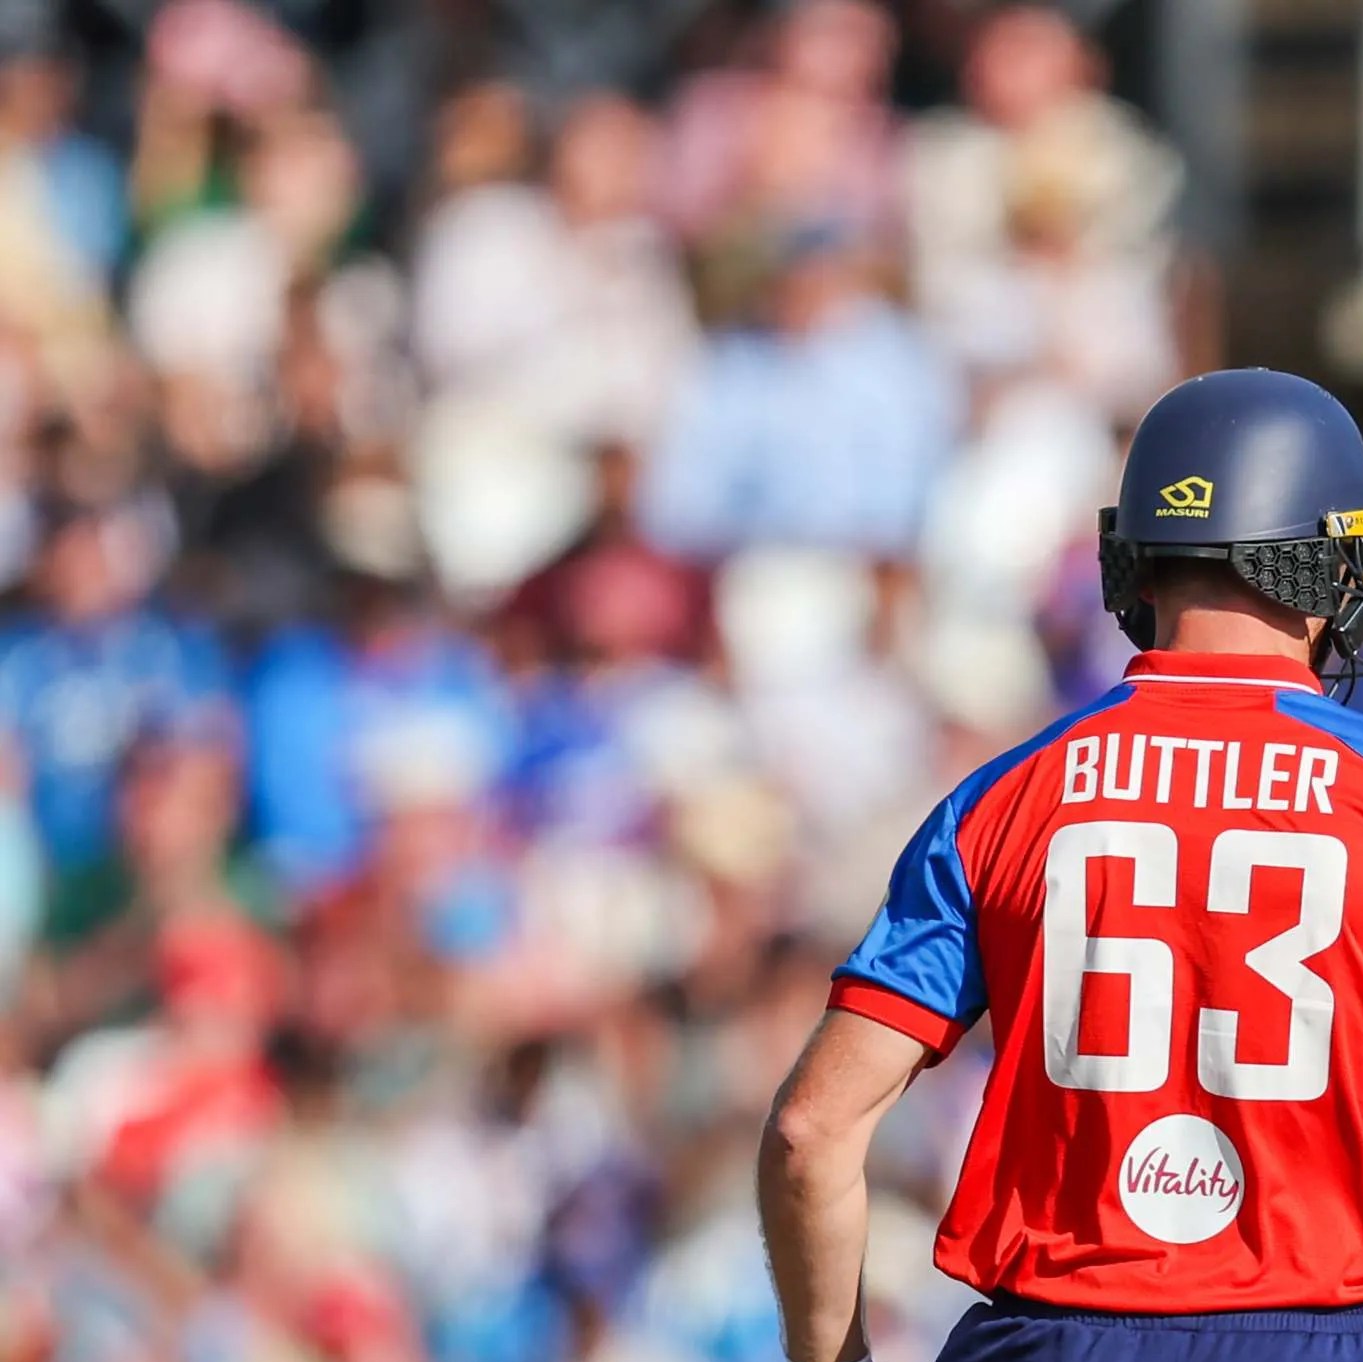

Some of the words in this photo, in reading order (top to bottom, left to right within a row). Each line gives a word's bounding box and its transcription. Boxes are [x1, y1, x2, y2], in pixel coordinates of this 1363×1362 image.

[1155, 508, 1210, 519] MASURI
[1062, 733, 1338, 814] BUTTLER
[1043, 820, 1348, 1101] 63
[1127, 1146, 1239, 1213] Vitality
